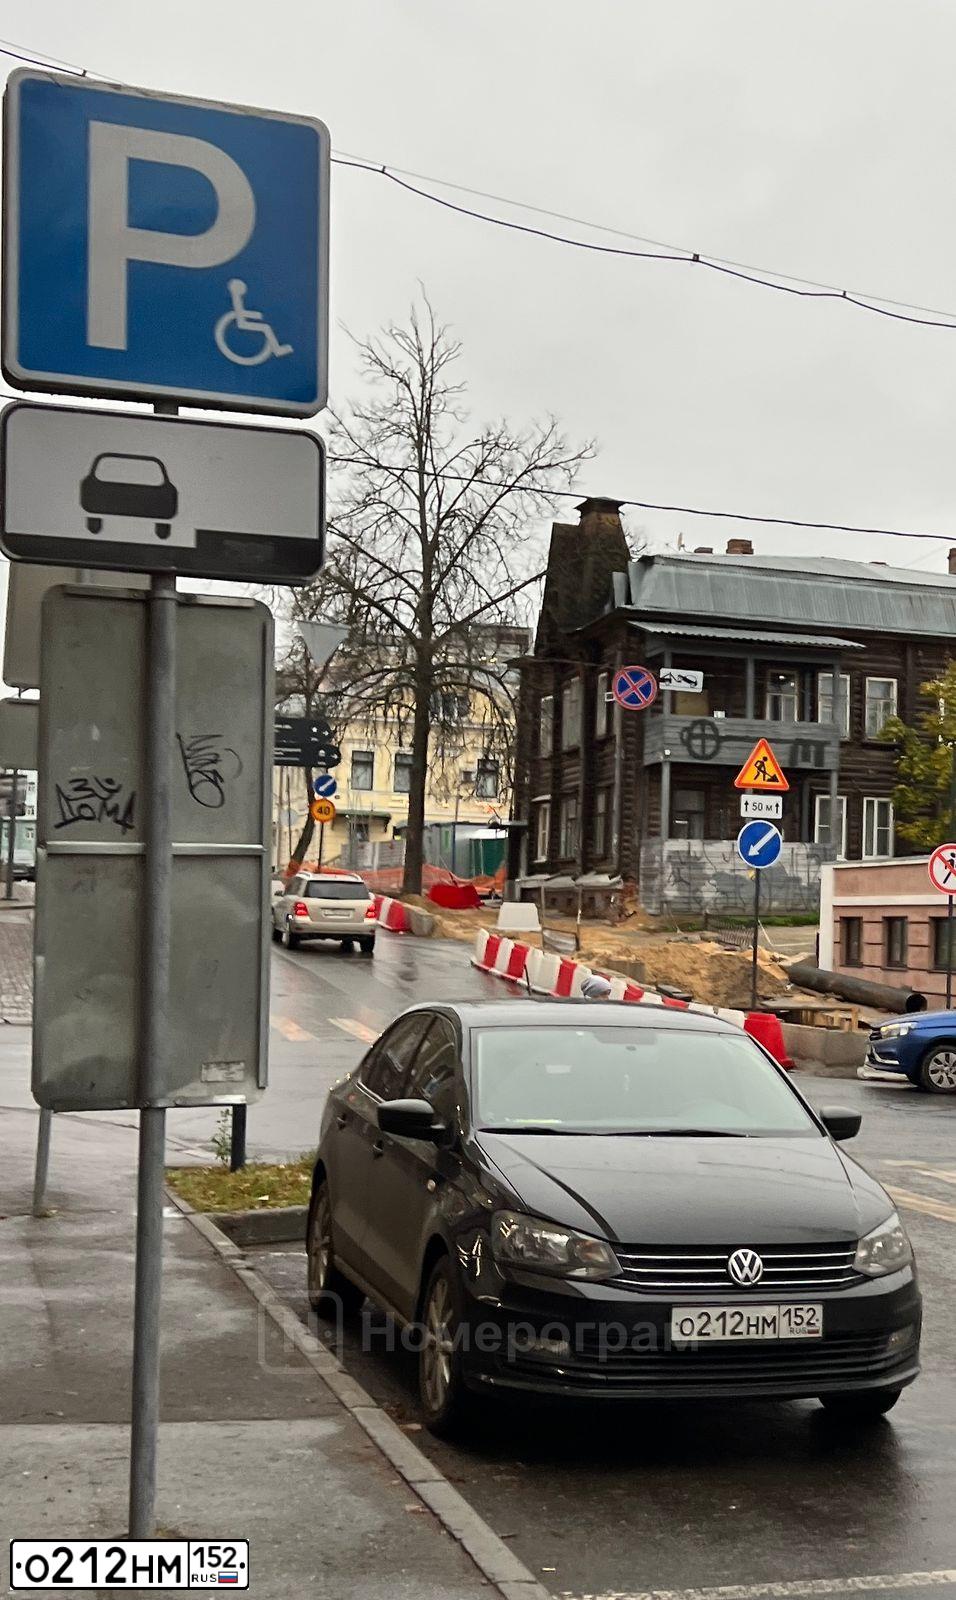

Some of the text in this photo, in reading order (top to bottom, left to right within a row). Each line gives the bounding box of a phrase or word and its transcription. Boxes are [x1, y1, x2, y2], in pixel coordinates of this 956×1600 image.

[86, 120, 256, 351] P
[316, 806, 331, 815] 40
[752, 802, 763, 811] 50
[783, 1307, 816, 1326] 152
